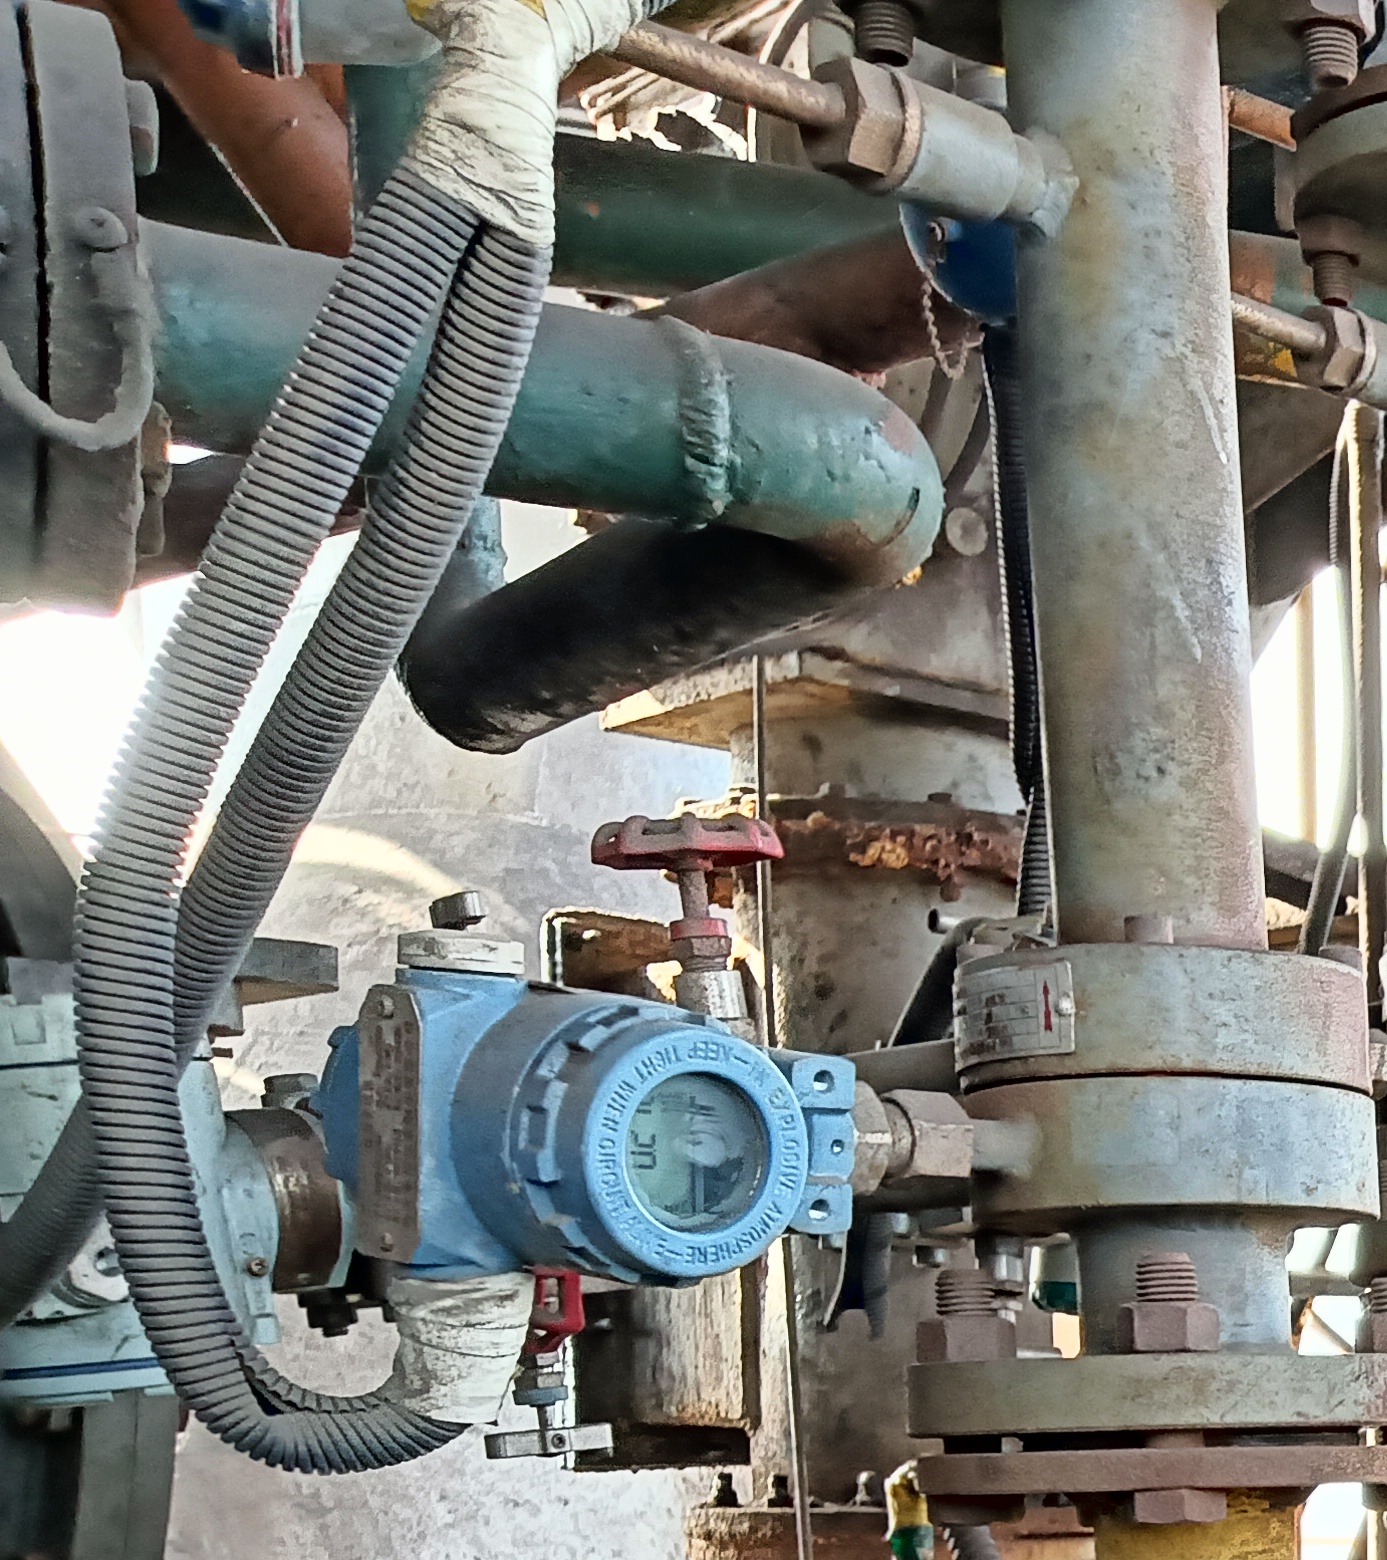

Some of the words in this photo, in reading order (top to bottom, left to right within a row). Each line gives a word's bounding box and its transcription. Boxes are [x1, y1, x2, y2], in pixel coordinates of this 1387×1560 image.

[633, 1045, 681, 1084] TIGHT
[687, 1041, 733, 1061] KEEP
[601, 1080, 637, 1133] WHEN
[685, 1202, 782, 1265] ATMOSPHERE
